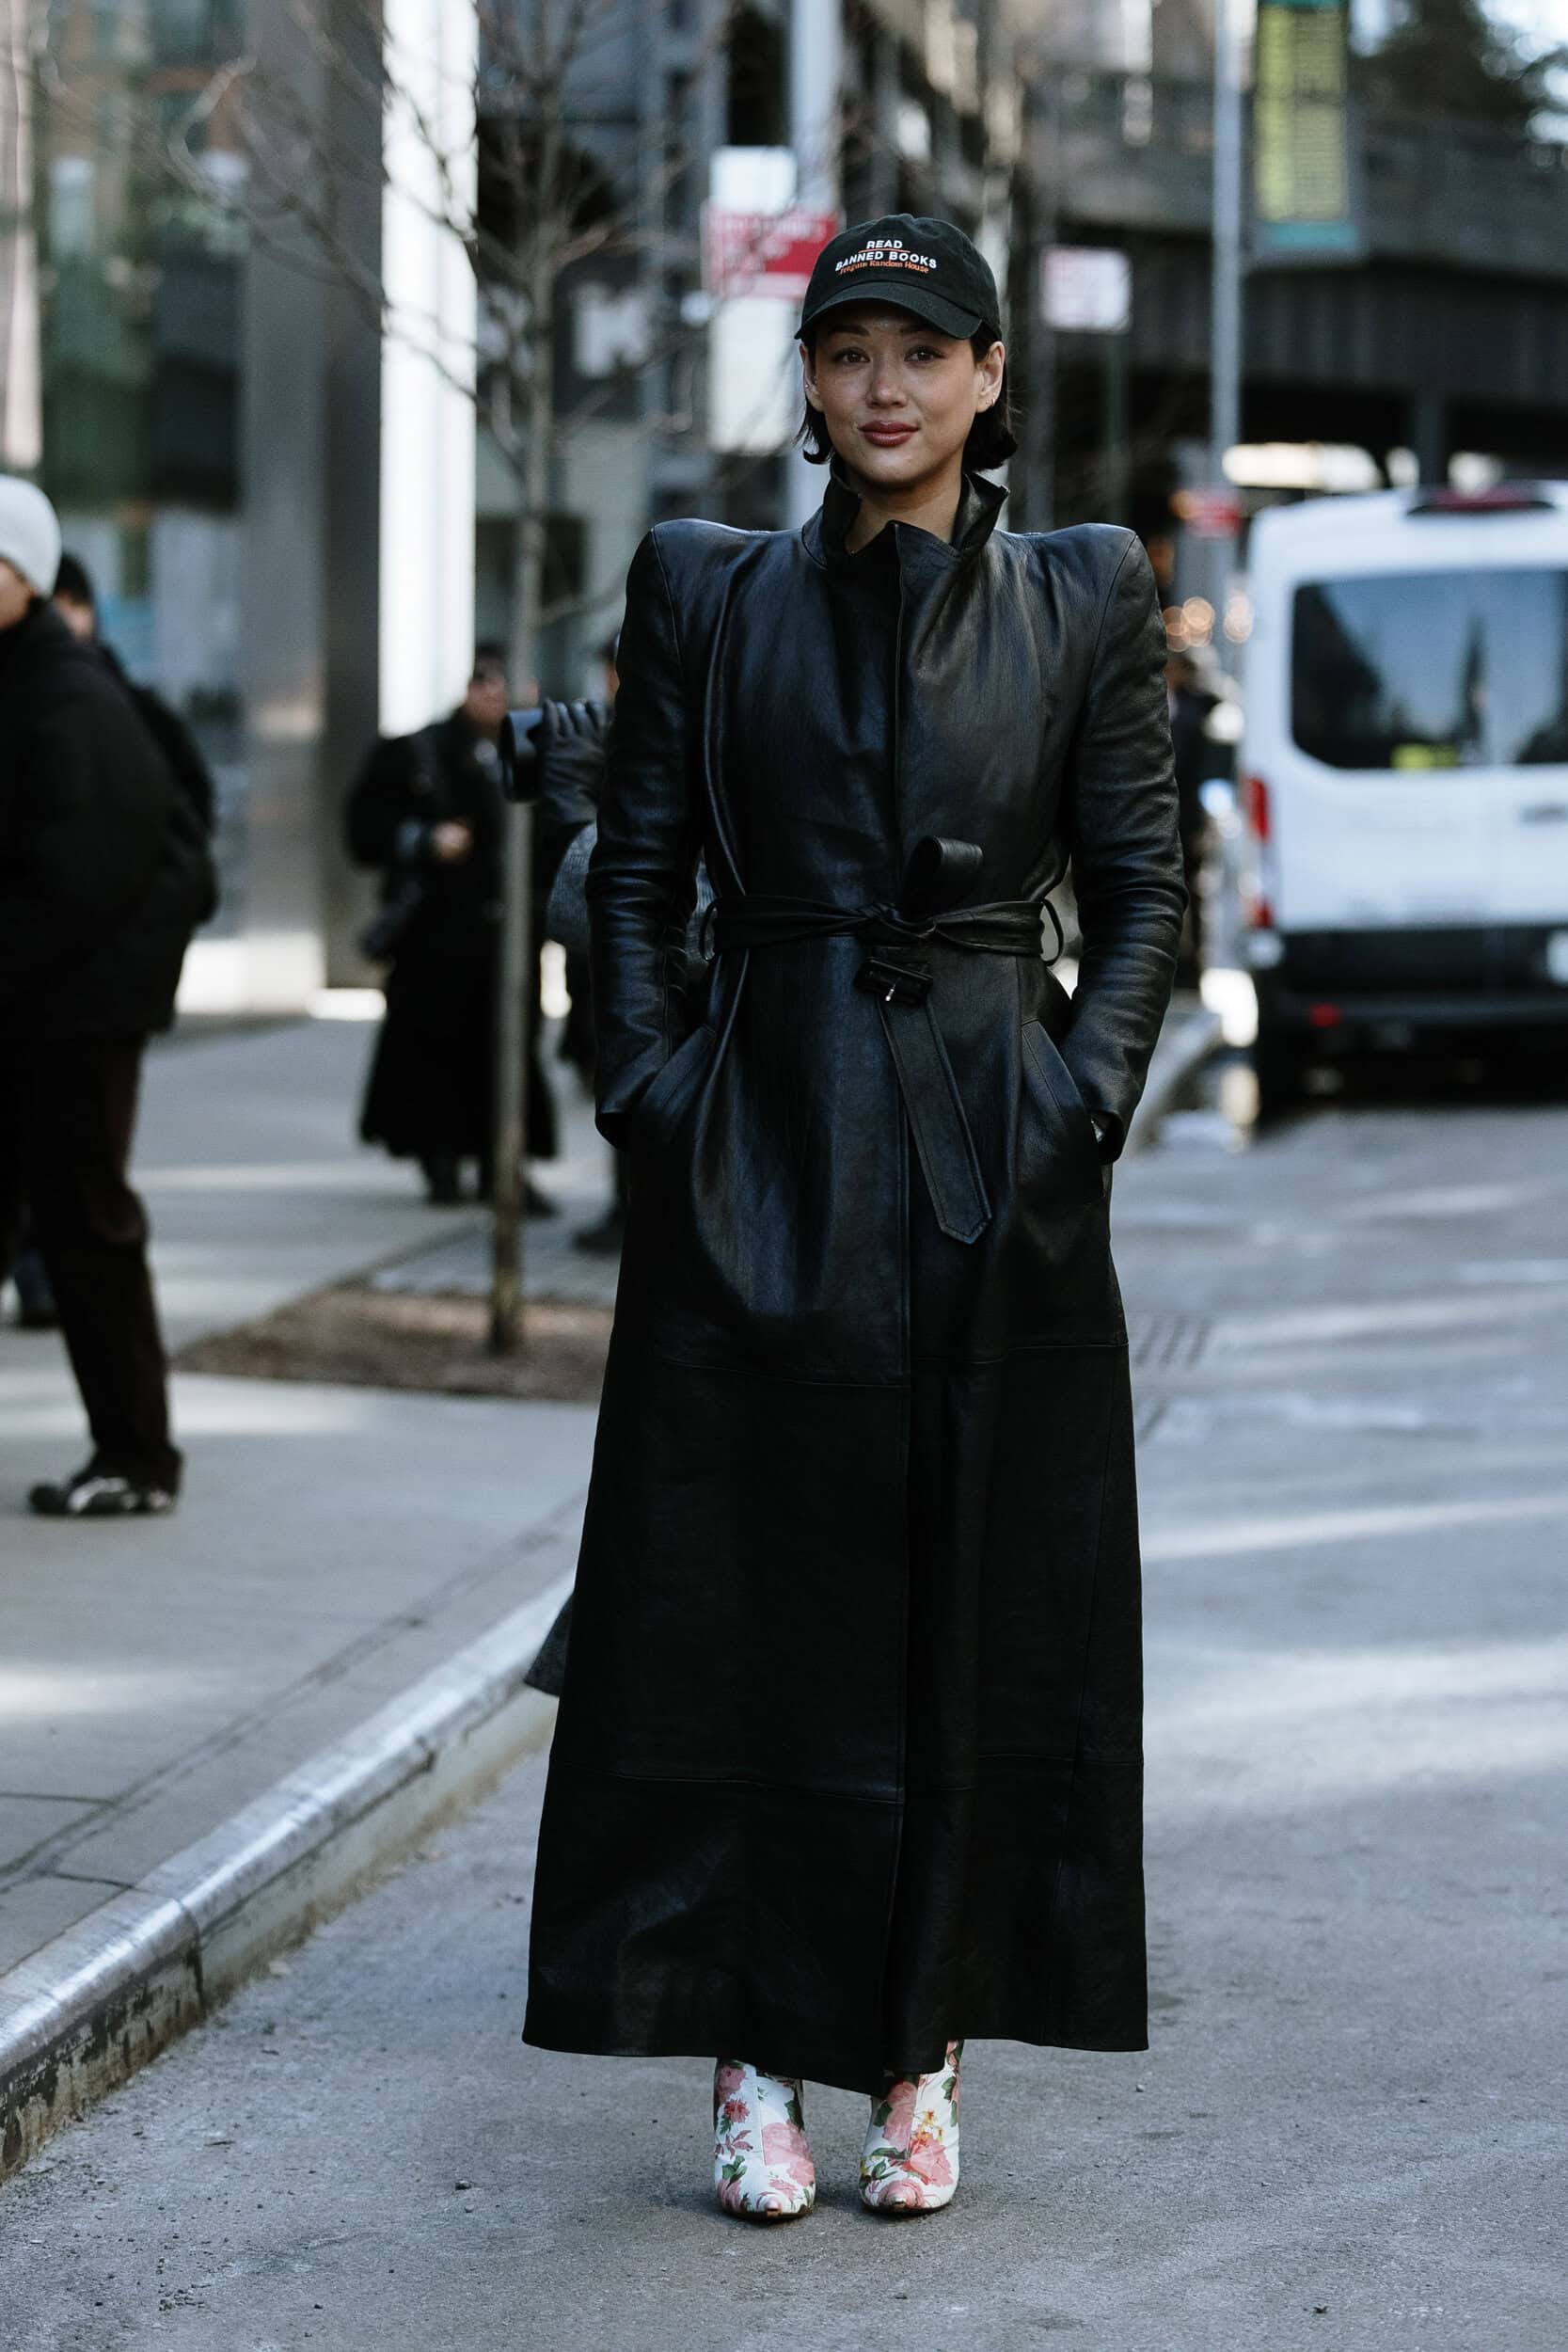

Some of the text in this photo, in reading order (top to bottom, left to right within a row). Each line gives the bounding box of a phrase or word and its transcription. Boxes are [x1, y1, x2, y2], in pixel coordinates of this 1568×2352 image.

[866, 240, 903, 249] READ
[835, 251, 937, 271] BANNED BOOKS
[869, 260, 903, 268] Random
[904, 262, 929, 274] House
